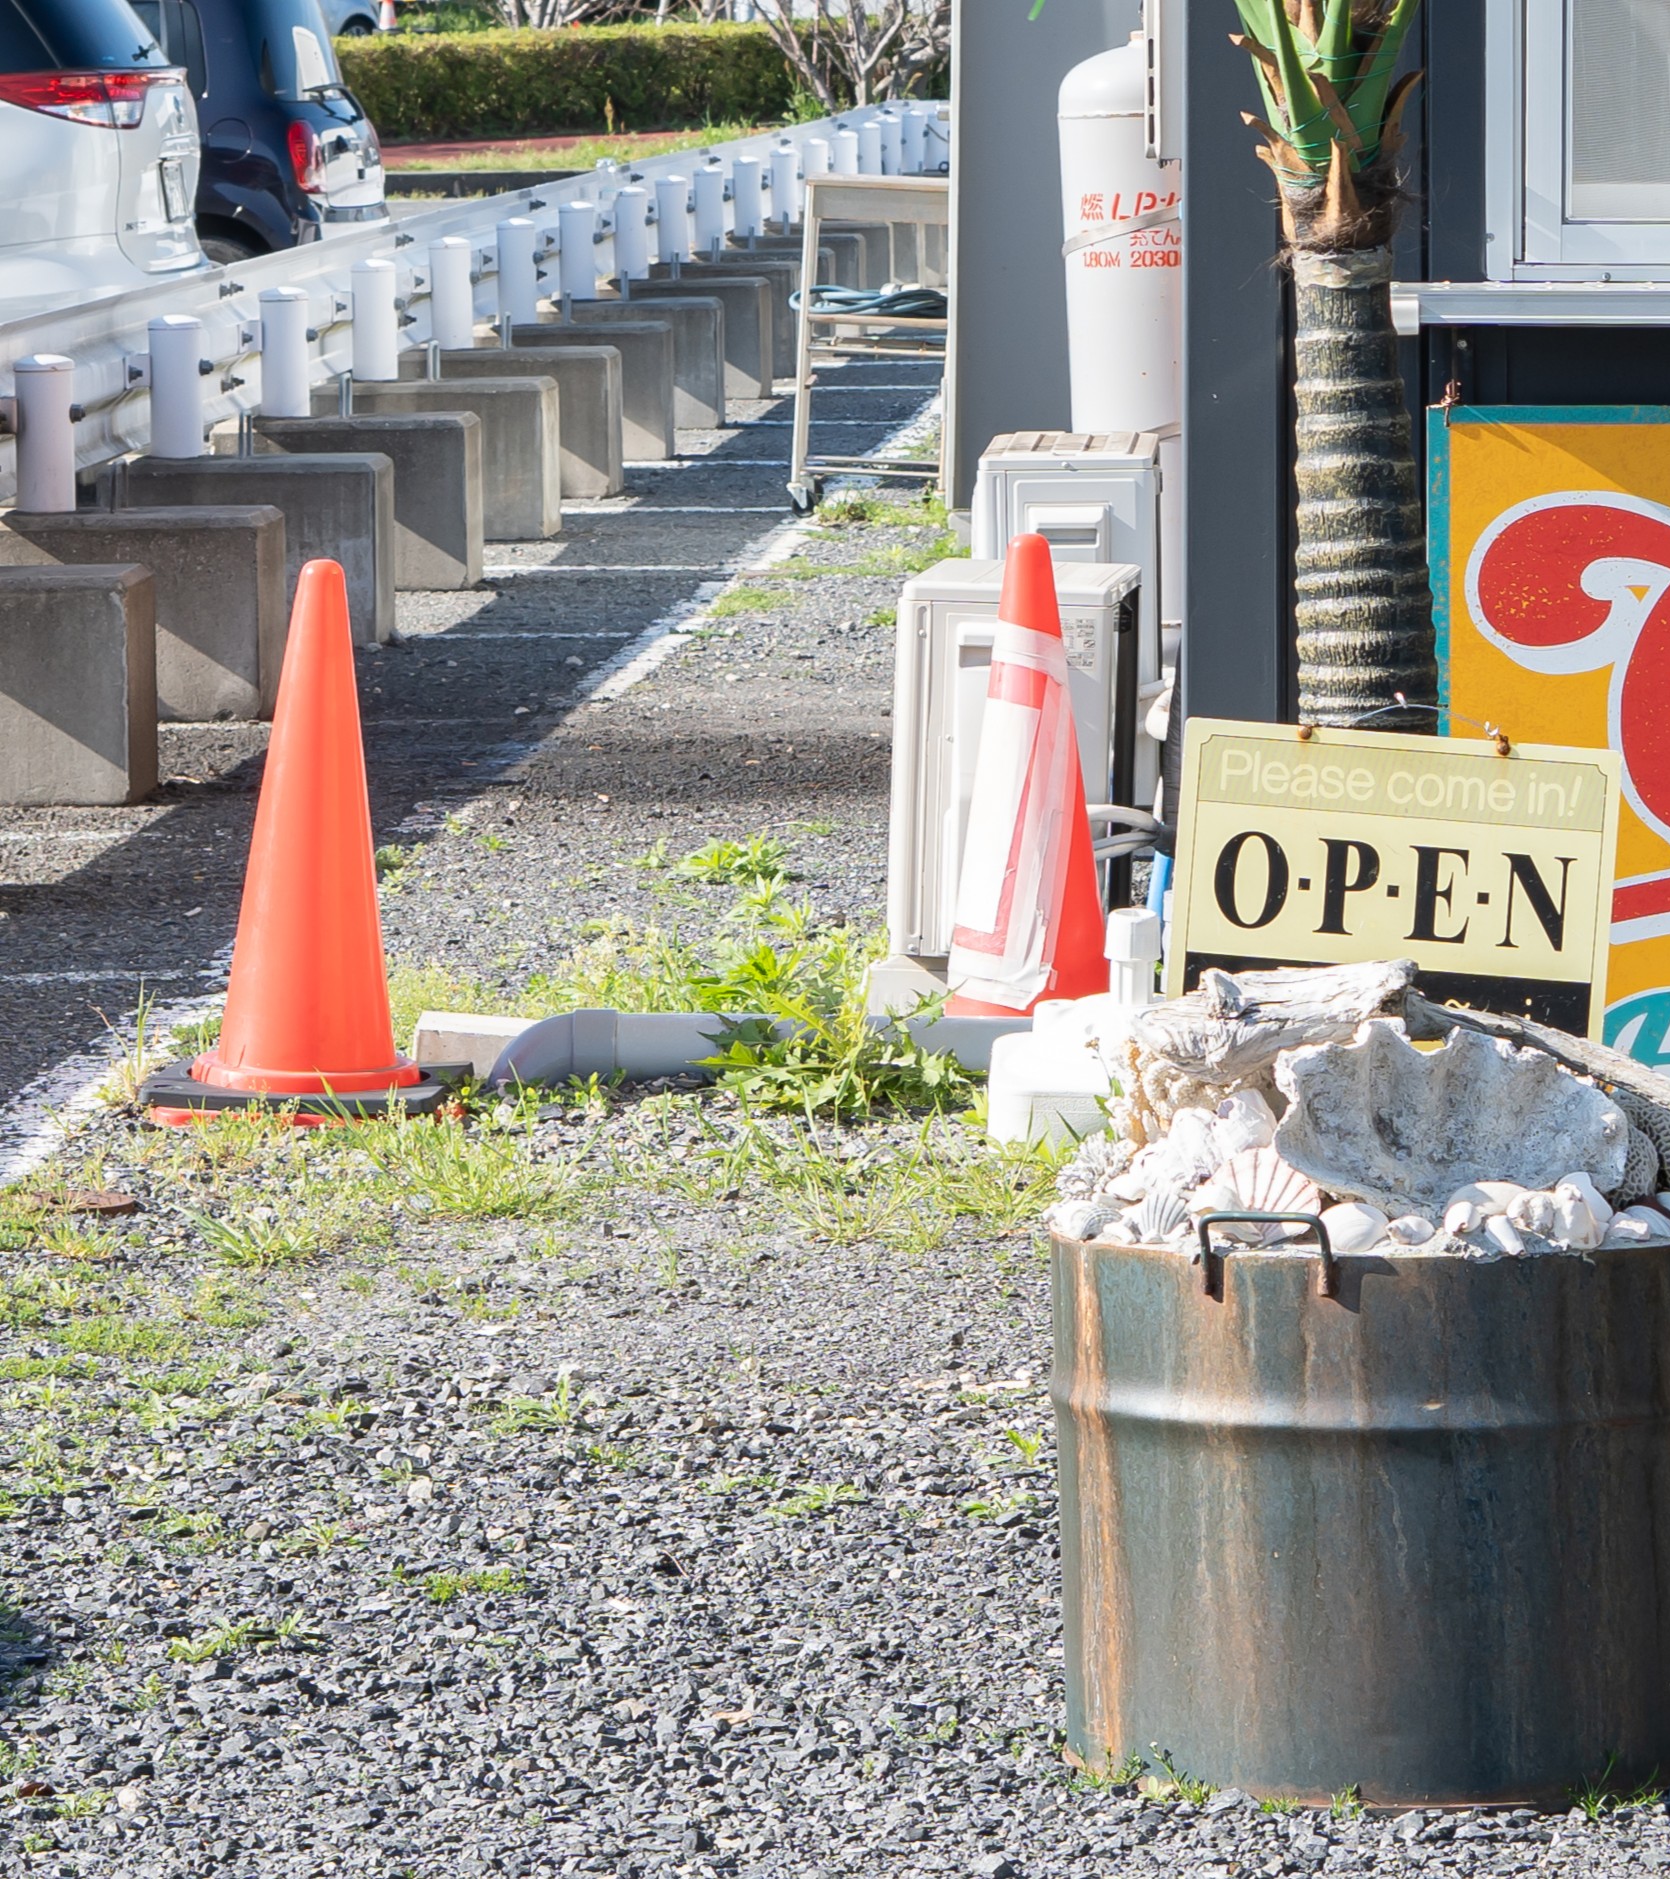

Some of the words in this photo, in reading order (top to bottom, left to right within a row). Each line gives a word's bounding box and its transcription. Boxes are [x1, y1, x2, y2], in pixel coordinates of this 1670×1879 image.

[1219, 749, 1375, 799] Please
[1387, 771, 1517, 810] come
[1527, 773, 1584, 818] in!
